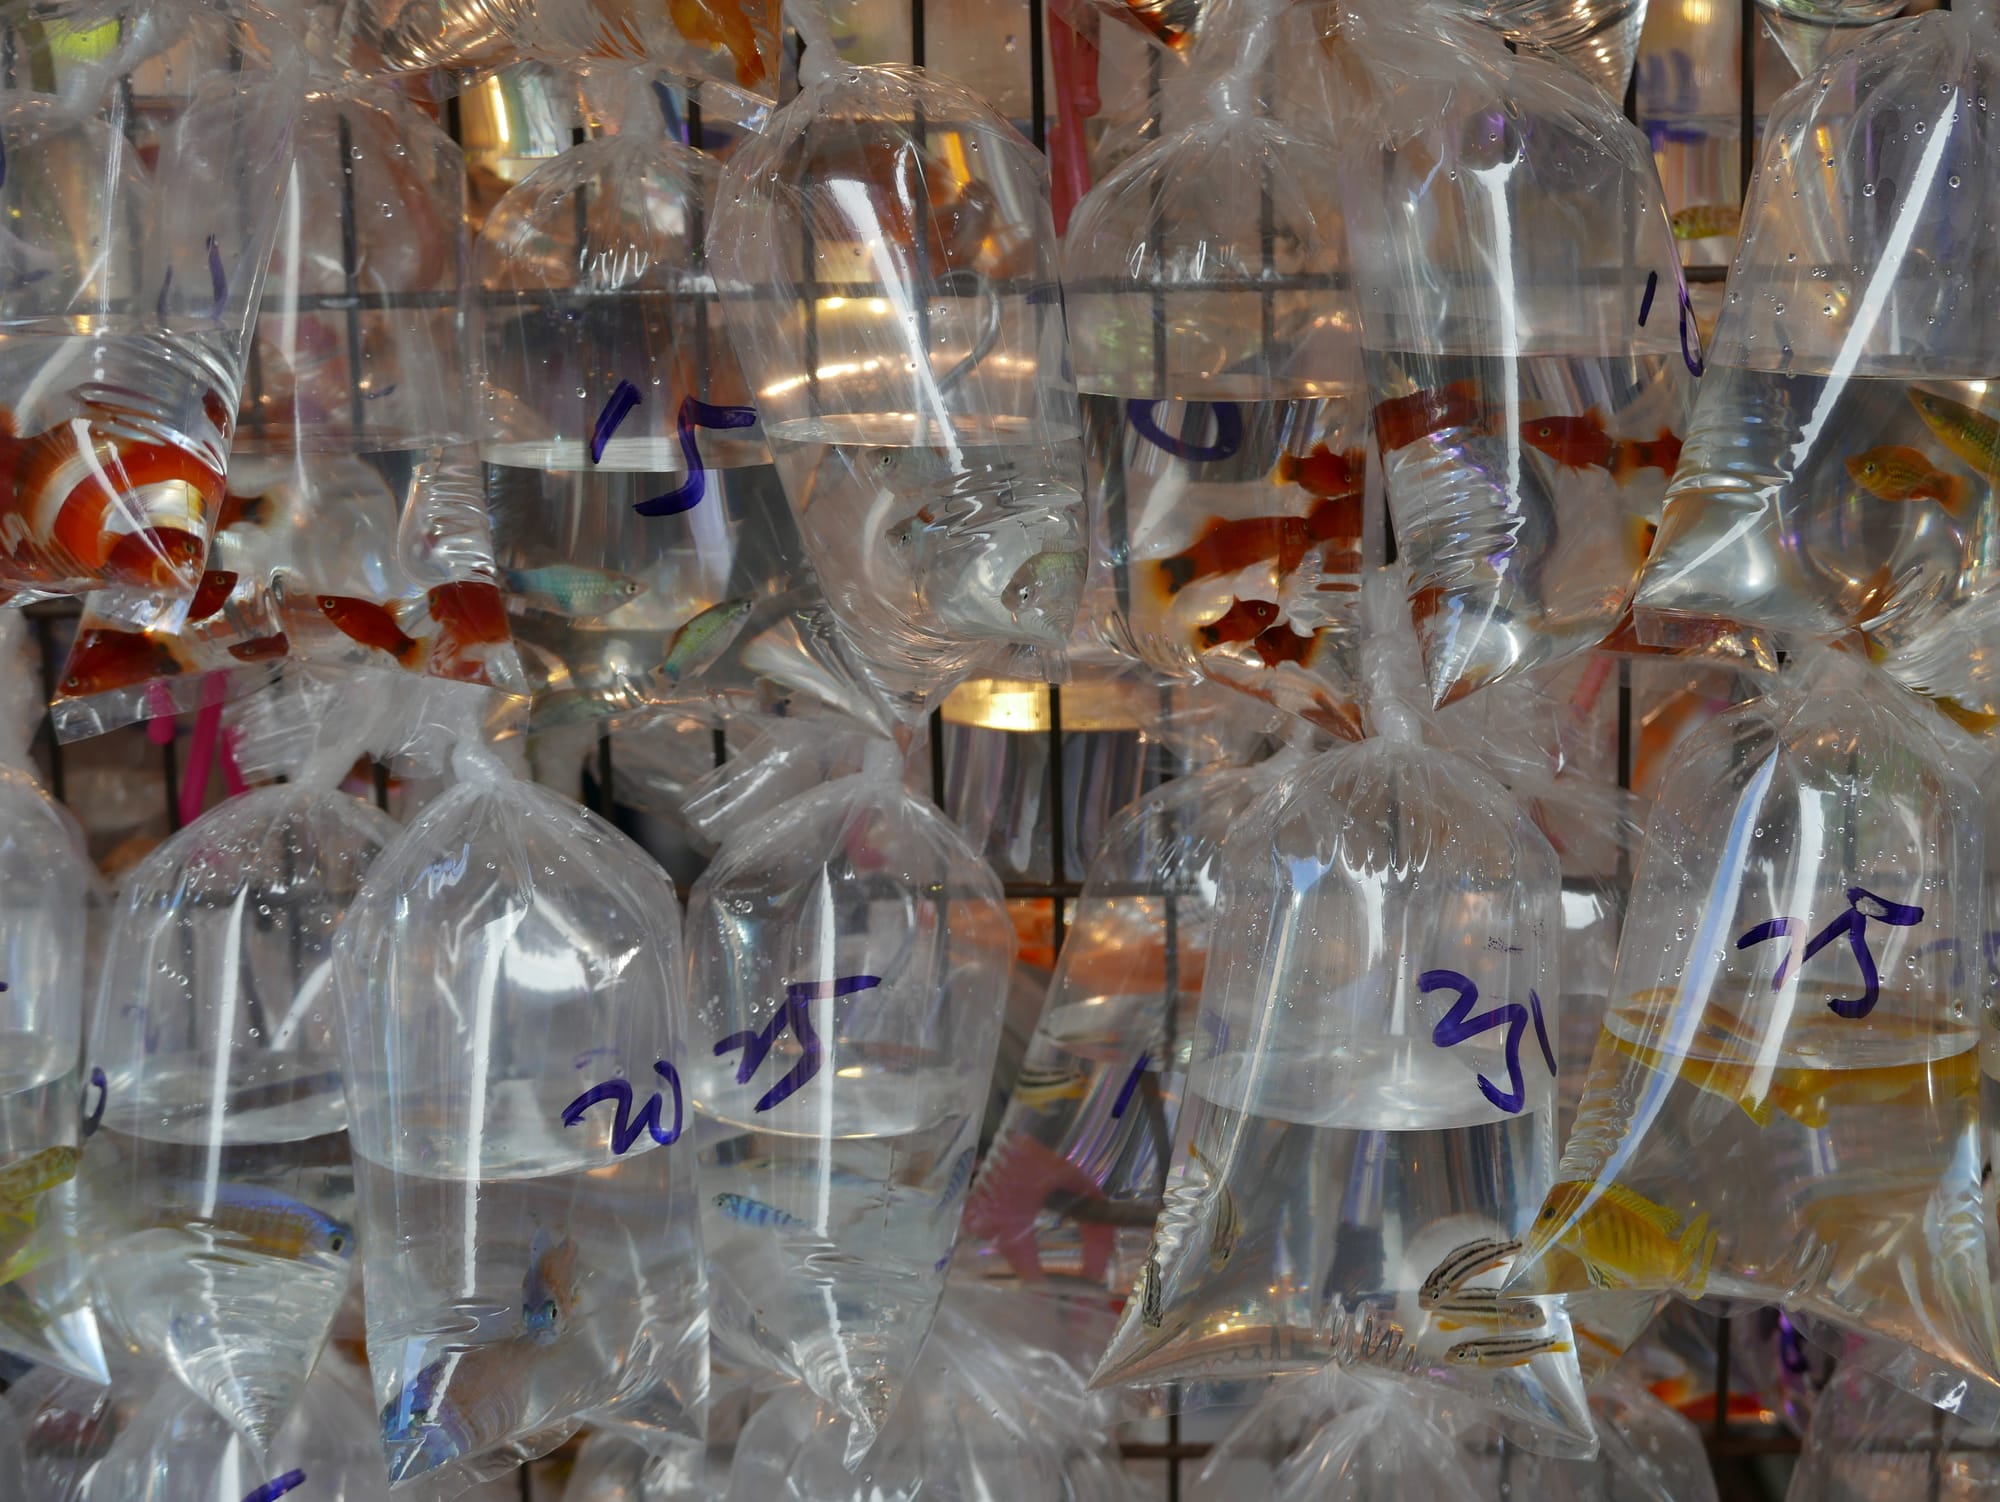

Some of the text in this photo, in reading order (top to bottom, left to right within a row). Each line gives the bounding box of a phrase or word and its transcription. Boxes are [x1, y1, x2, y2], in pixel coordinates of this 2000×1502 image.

[590, 379, 757, 517] 15
[1735, 886, 1925, 1019] 25
[561, 1060, 683, 1155] 20
[713, 975, 882, 1114] 25
